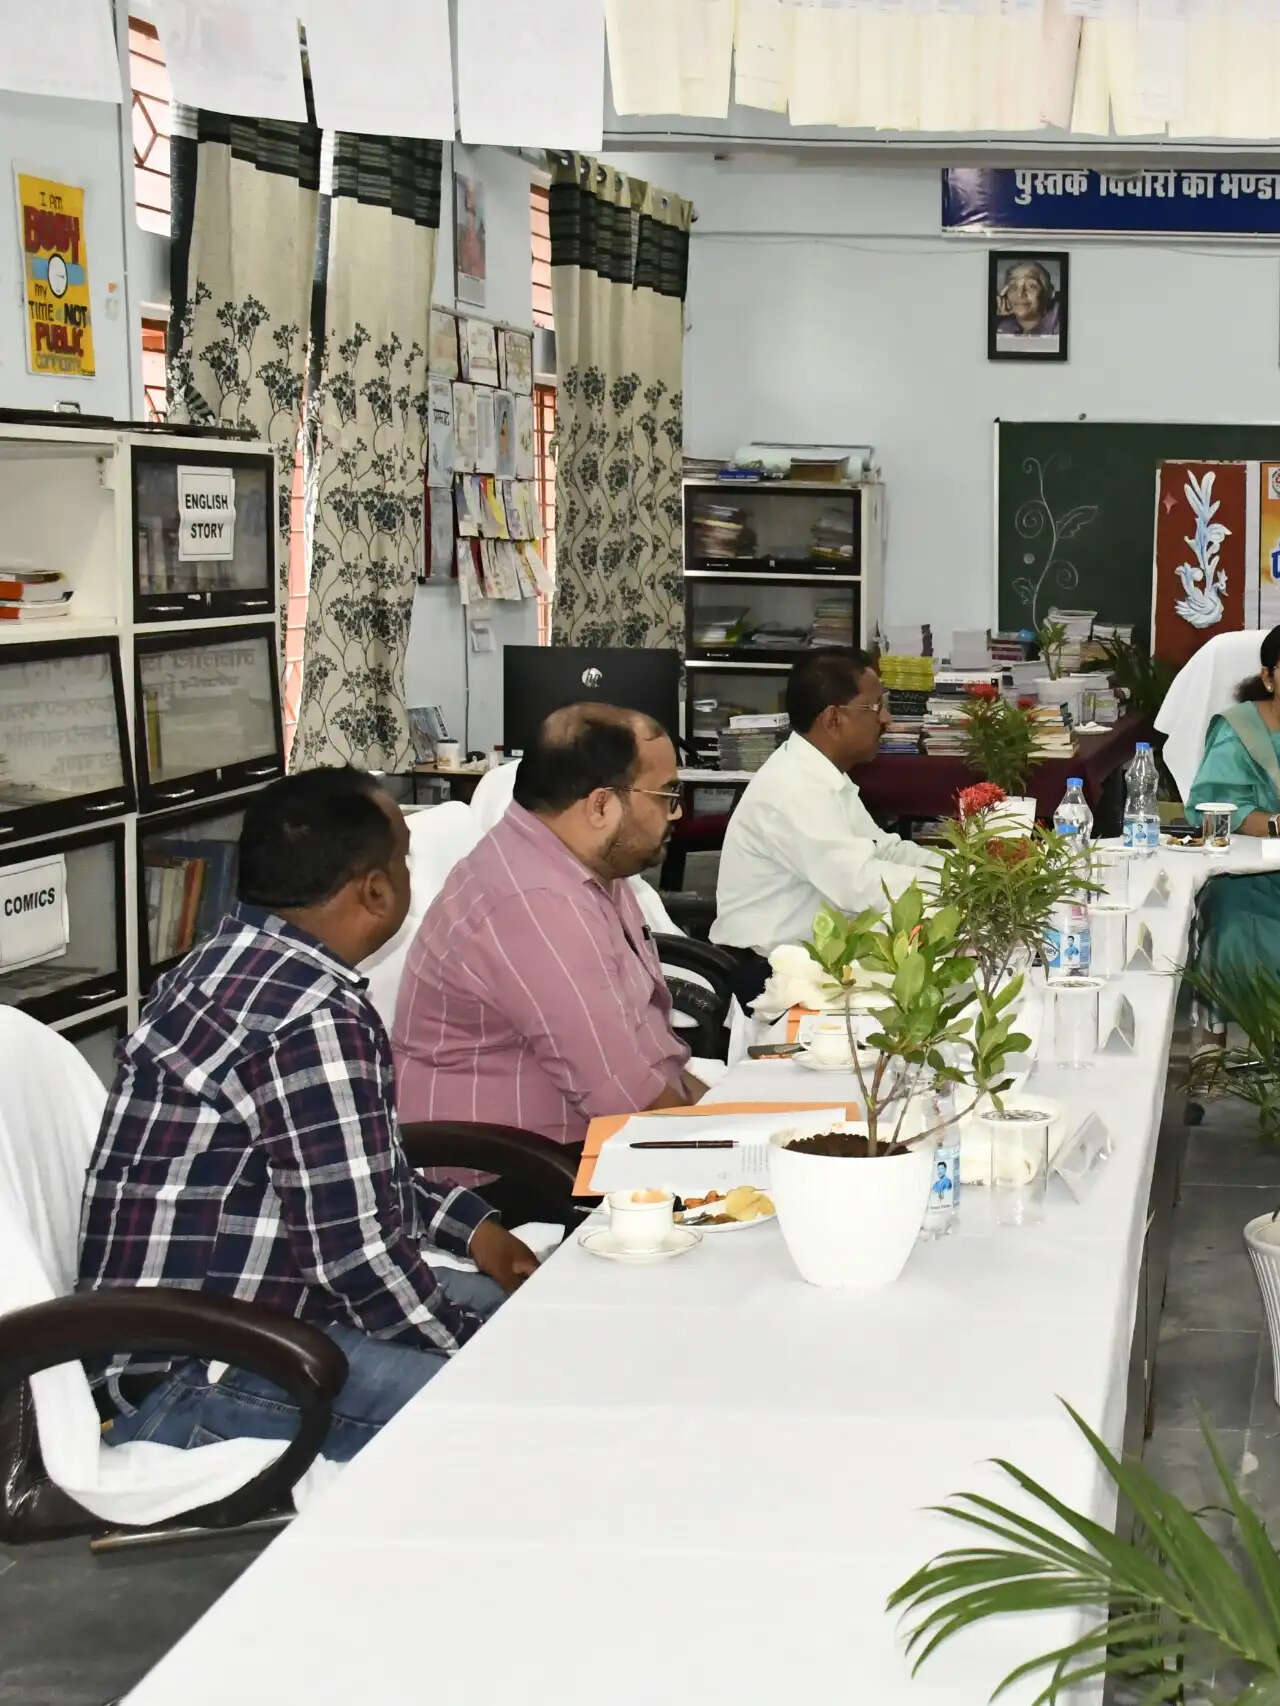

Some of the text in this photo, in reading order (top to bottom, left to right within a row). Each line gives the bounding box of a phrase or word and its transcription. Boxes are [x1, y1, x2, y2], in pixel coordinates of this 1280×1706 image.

[1181, 172, 1216, 199] का
[64, 303, 88, 329] NOT
[35, 322, 84, 357] PUBLIC
[185, 494, 229, 510] ENGLISH
[190, 522, 224, 539] STORY
[4, 887, 55, 917] COMICS
